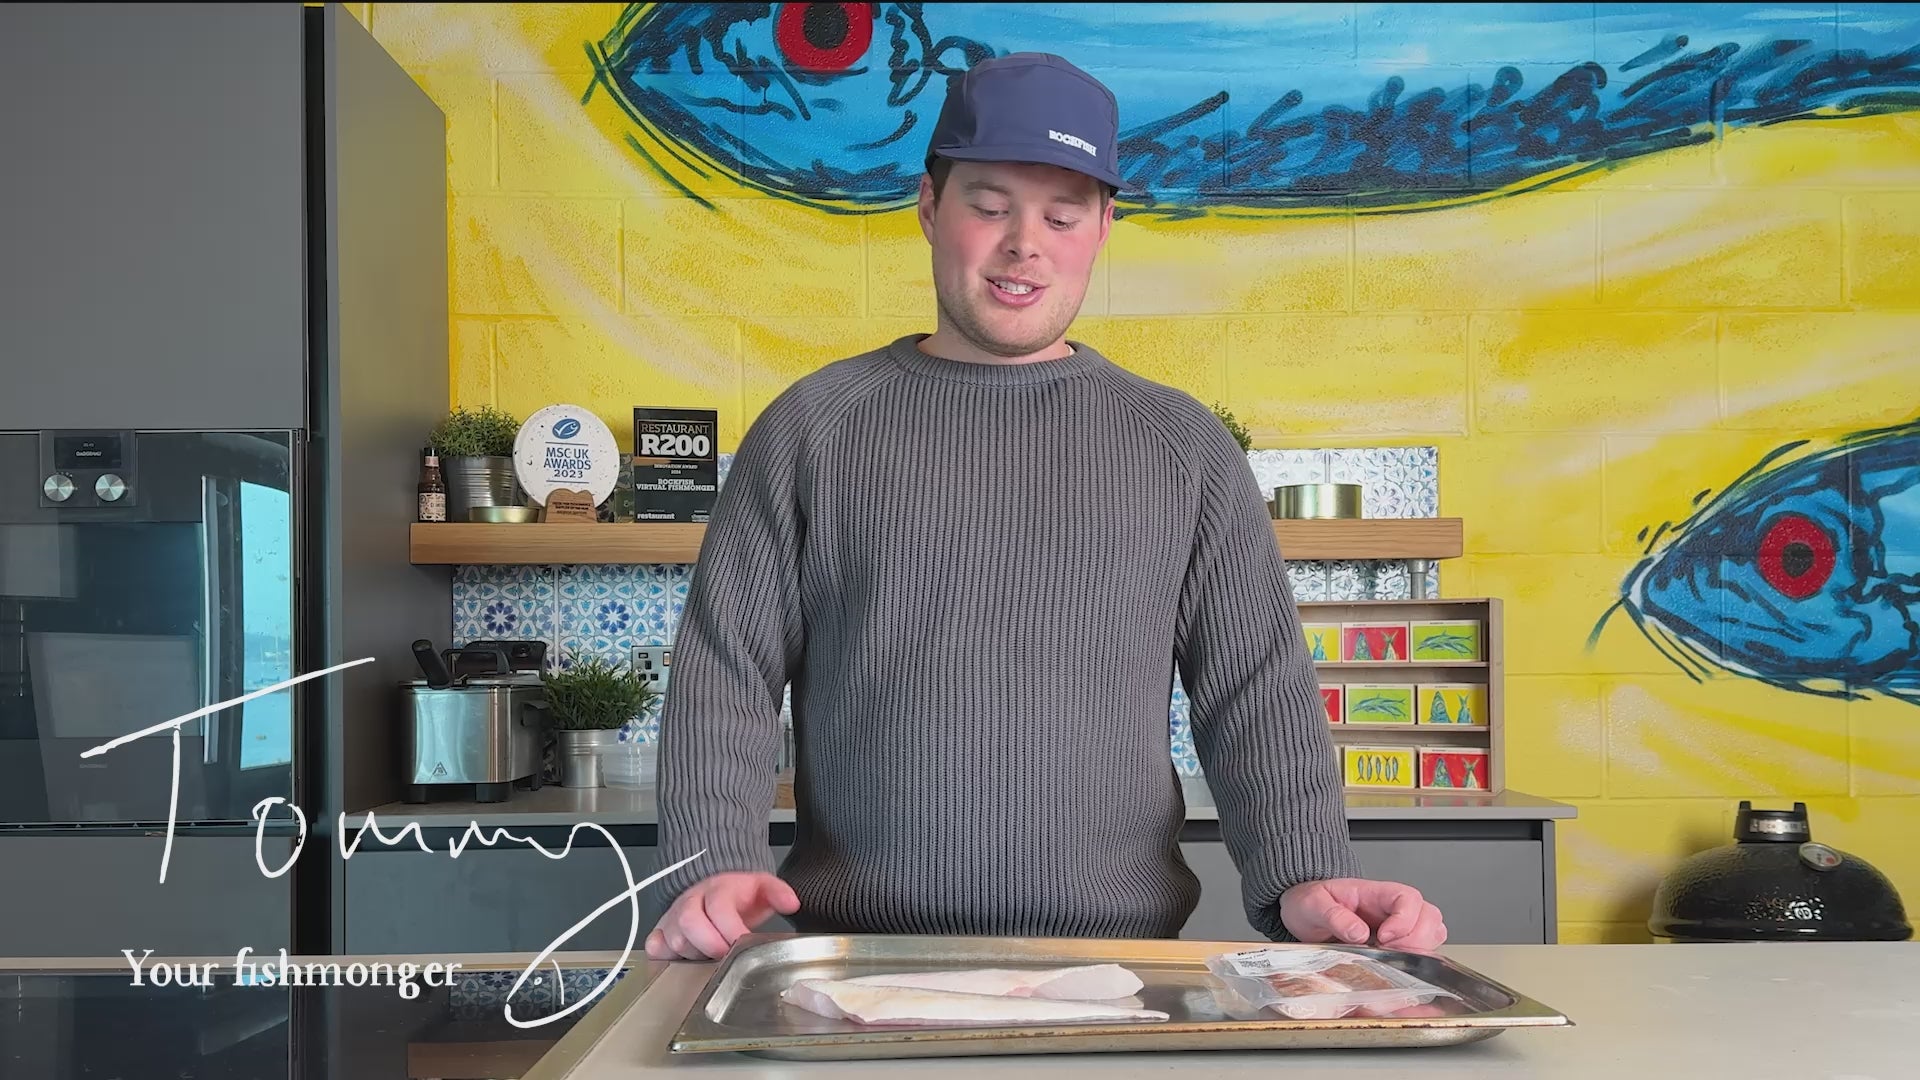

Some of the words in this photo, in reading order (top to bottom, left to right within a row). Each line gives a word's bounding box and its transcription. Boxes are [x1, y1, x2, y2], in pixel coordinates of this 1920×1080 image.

[641, 423, 709, 434] RESTAURANT
[641, 433, 710, 457] R200
[546, 447, 571, 458] MSC
[574, 448, 589, 460] UK
[544, 457, 592, 470] AWARDS
[554, 469, 583, 479] 2023
[636, 483, 667, 491] VIRTUAL
[667, 484, 716, 492] FISHMONGER
[637, 512, 675, 520] restaurant
